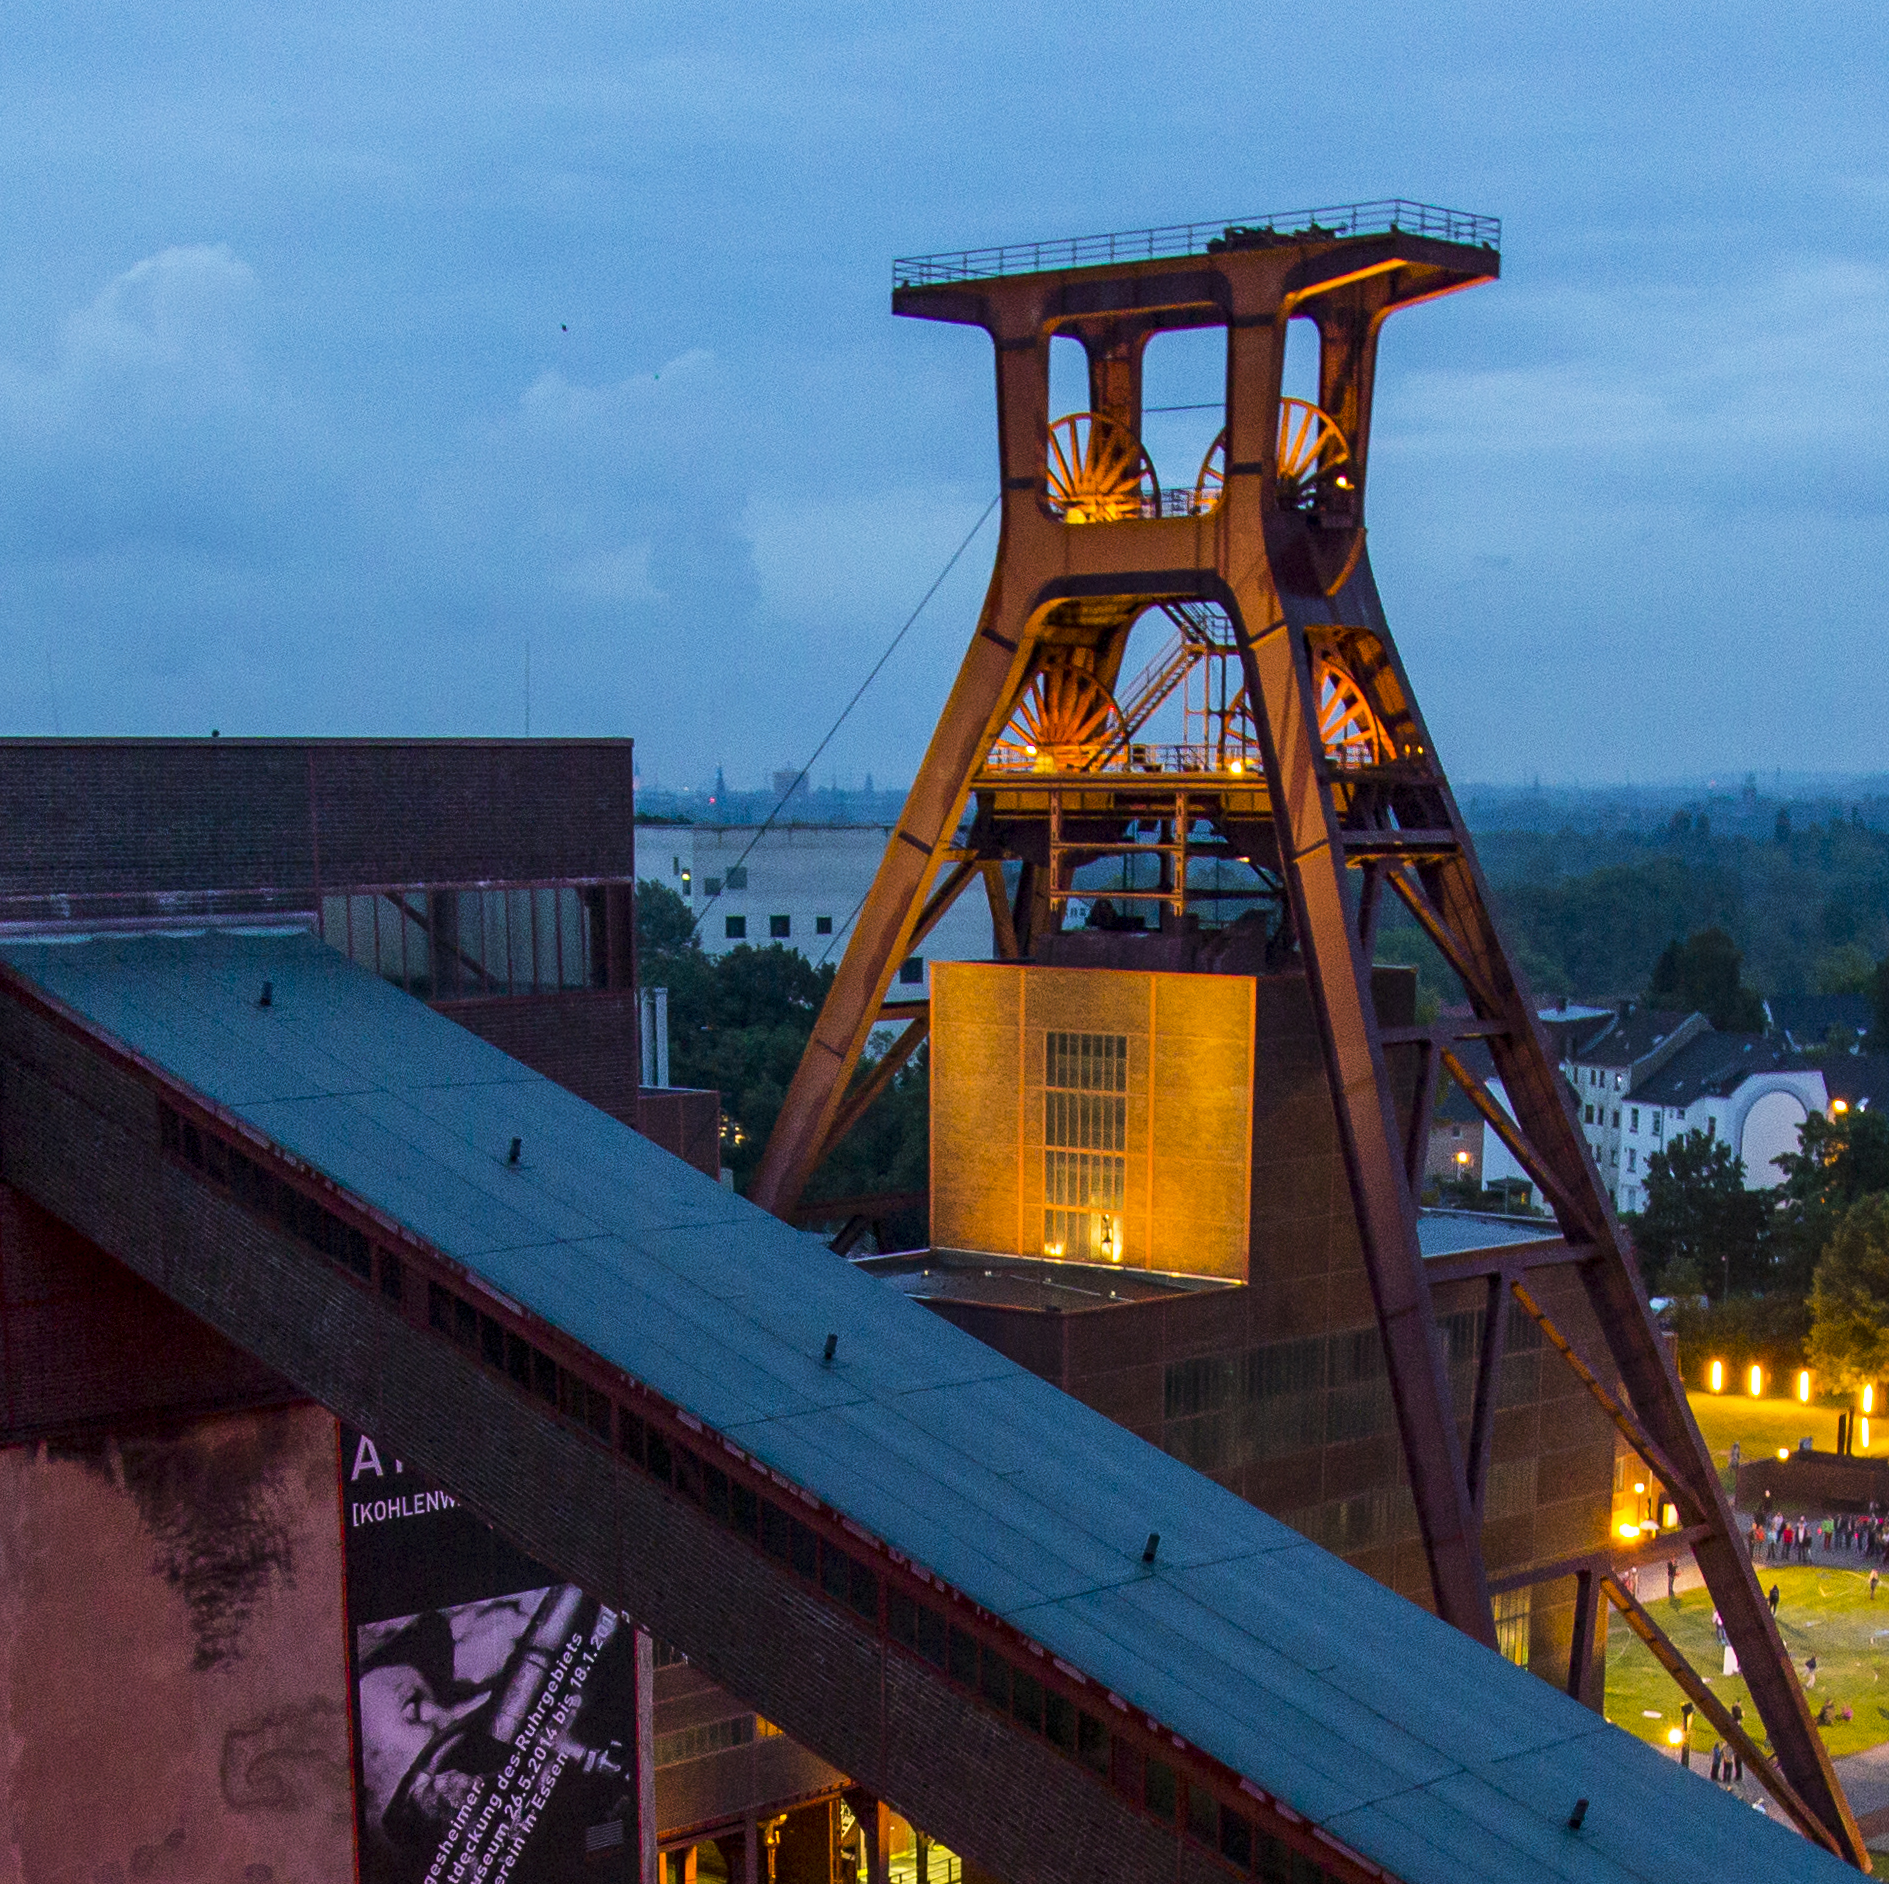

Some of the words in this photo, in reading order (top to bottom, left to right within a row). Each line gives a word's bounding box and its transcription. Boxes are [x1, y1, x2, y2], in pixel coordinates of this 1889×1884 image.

[352, 1490, 461, 1527] [KOHLENW
[497, 1753, 520, 1791] des
[514, 1632, 582, 1751] Ruhrgebiets
[502, 1725, 557, 1819] 26.5.2014
[551, 1691, 575, 1724] bis
[518, 1811, 537, 1833] in
[531, 1751, 568, 1810] Essen
